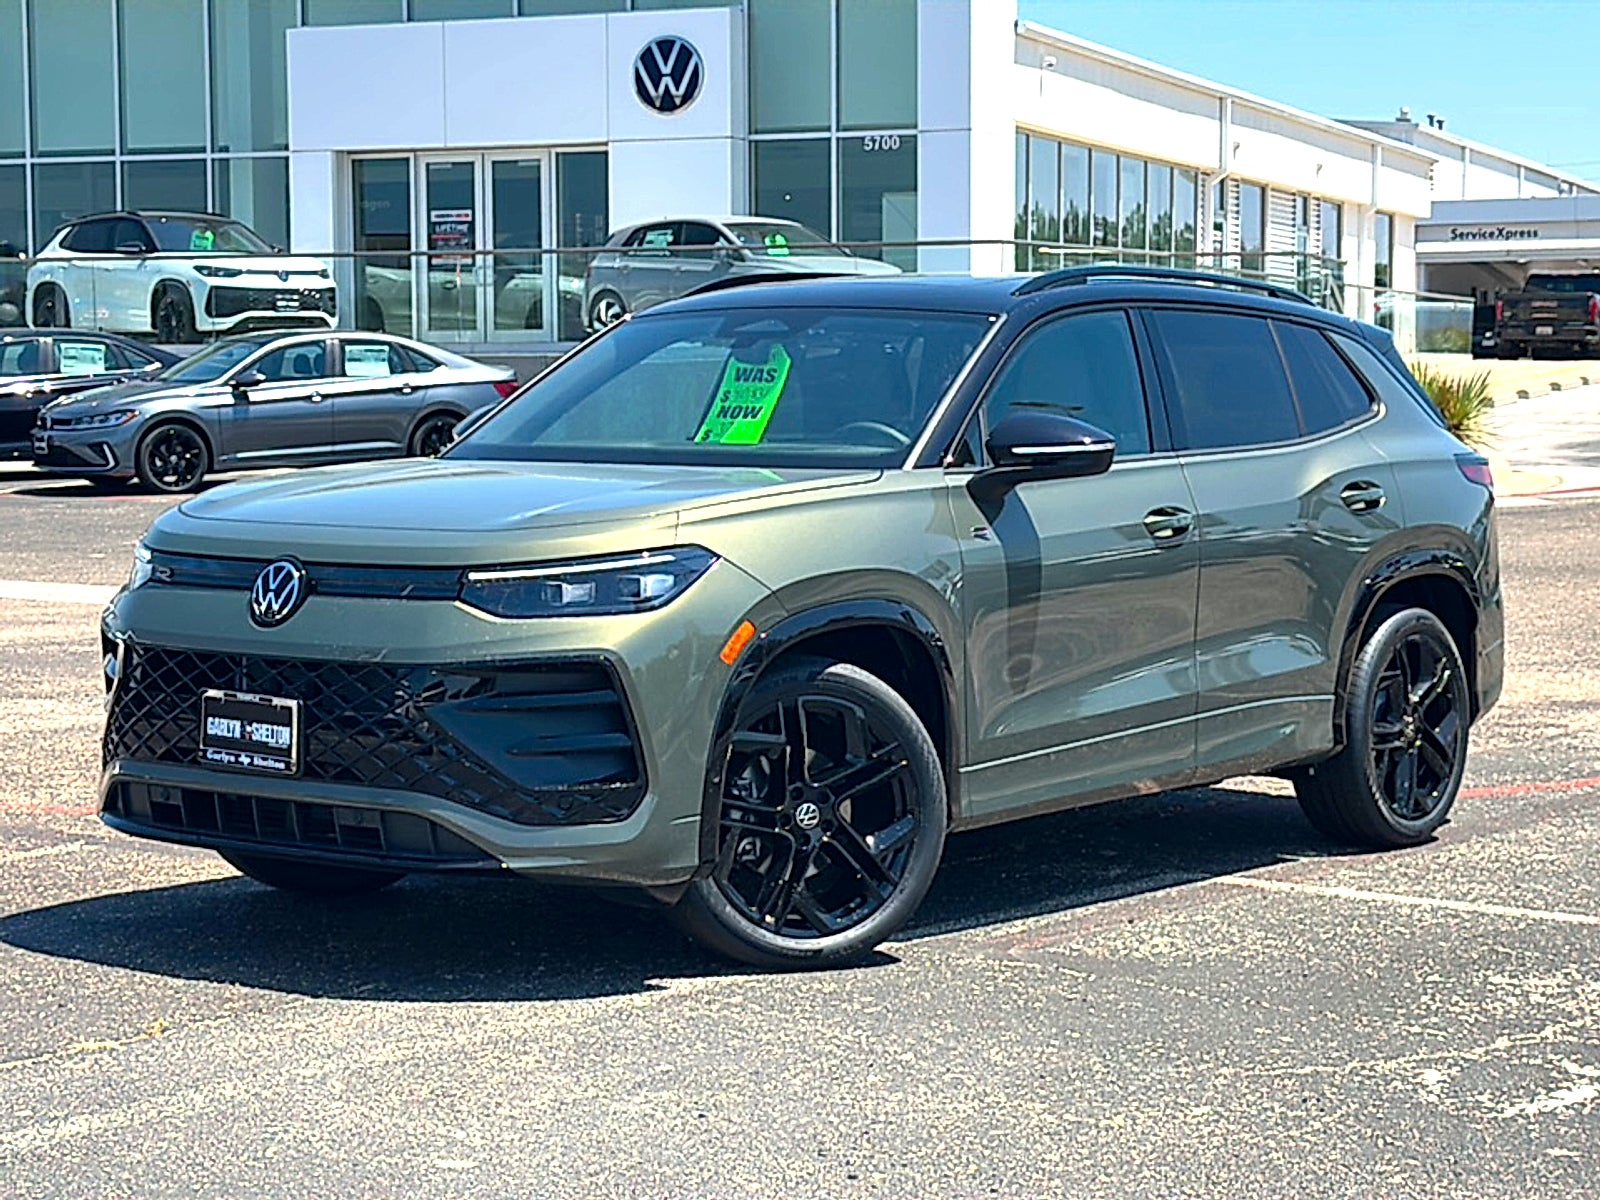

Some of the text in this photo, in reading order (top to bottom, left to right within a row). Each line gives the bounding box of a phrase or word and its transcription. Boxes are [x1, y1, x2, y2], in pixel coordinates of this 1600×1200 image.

[634, 37, 703, 112] VW
[863, 136, 900, 151] 5700
[1450, 227, 1539, 241] ServiceXpress
[734, 367, 778, 383] WAS
[717, 404, 763, 419] NOW
[206, 716, 291, 746] GARLYN SHELTON
